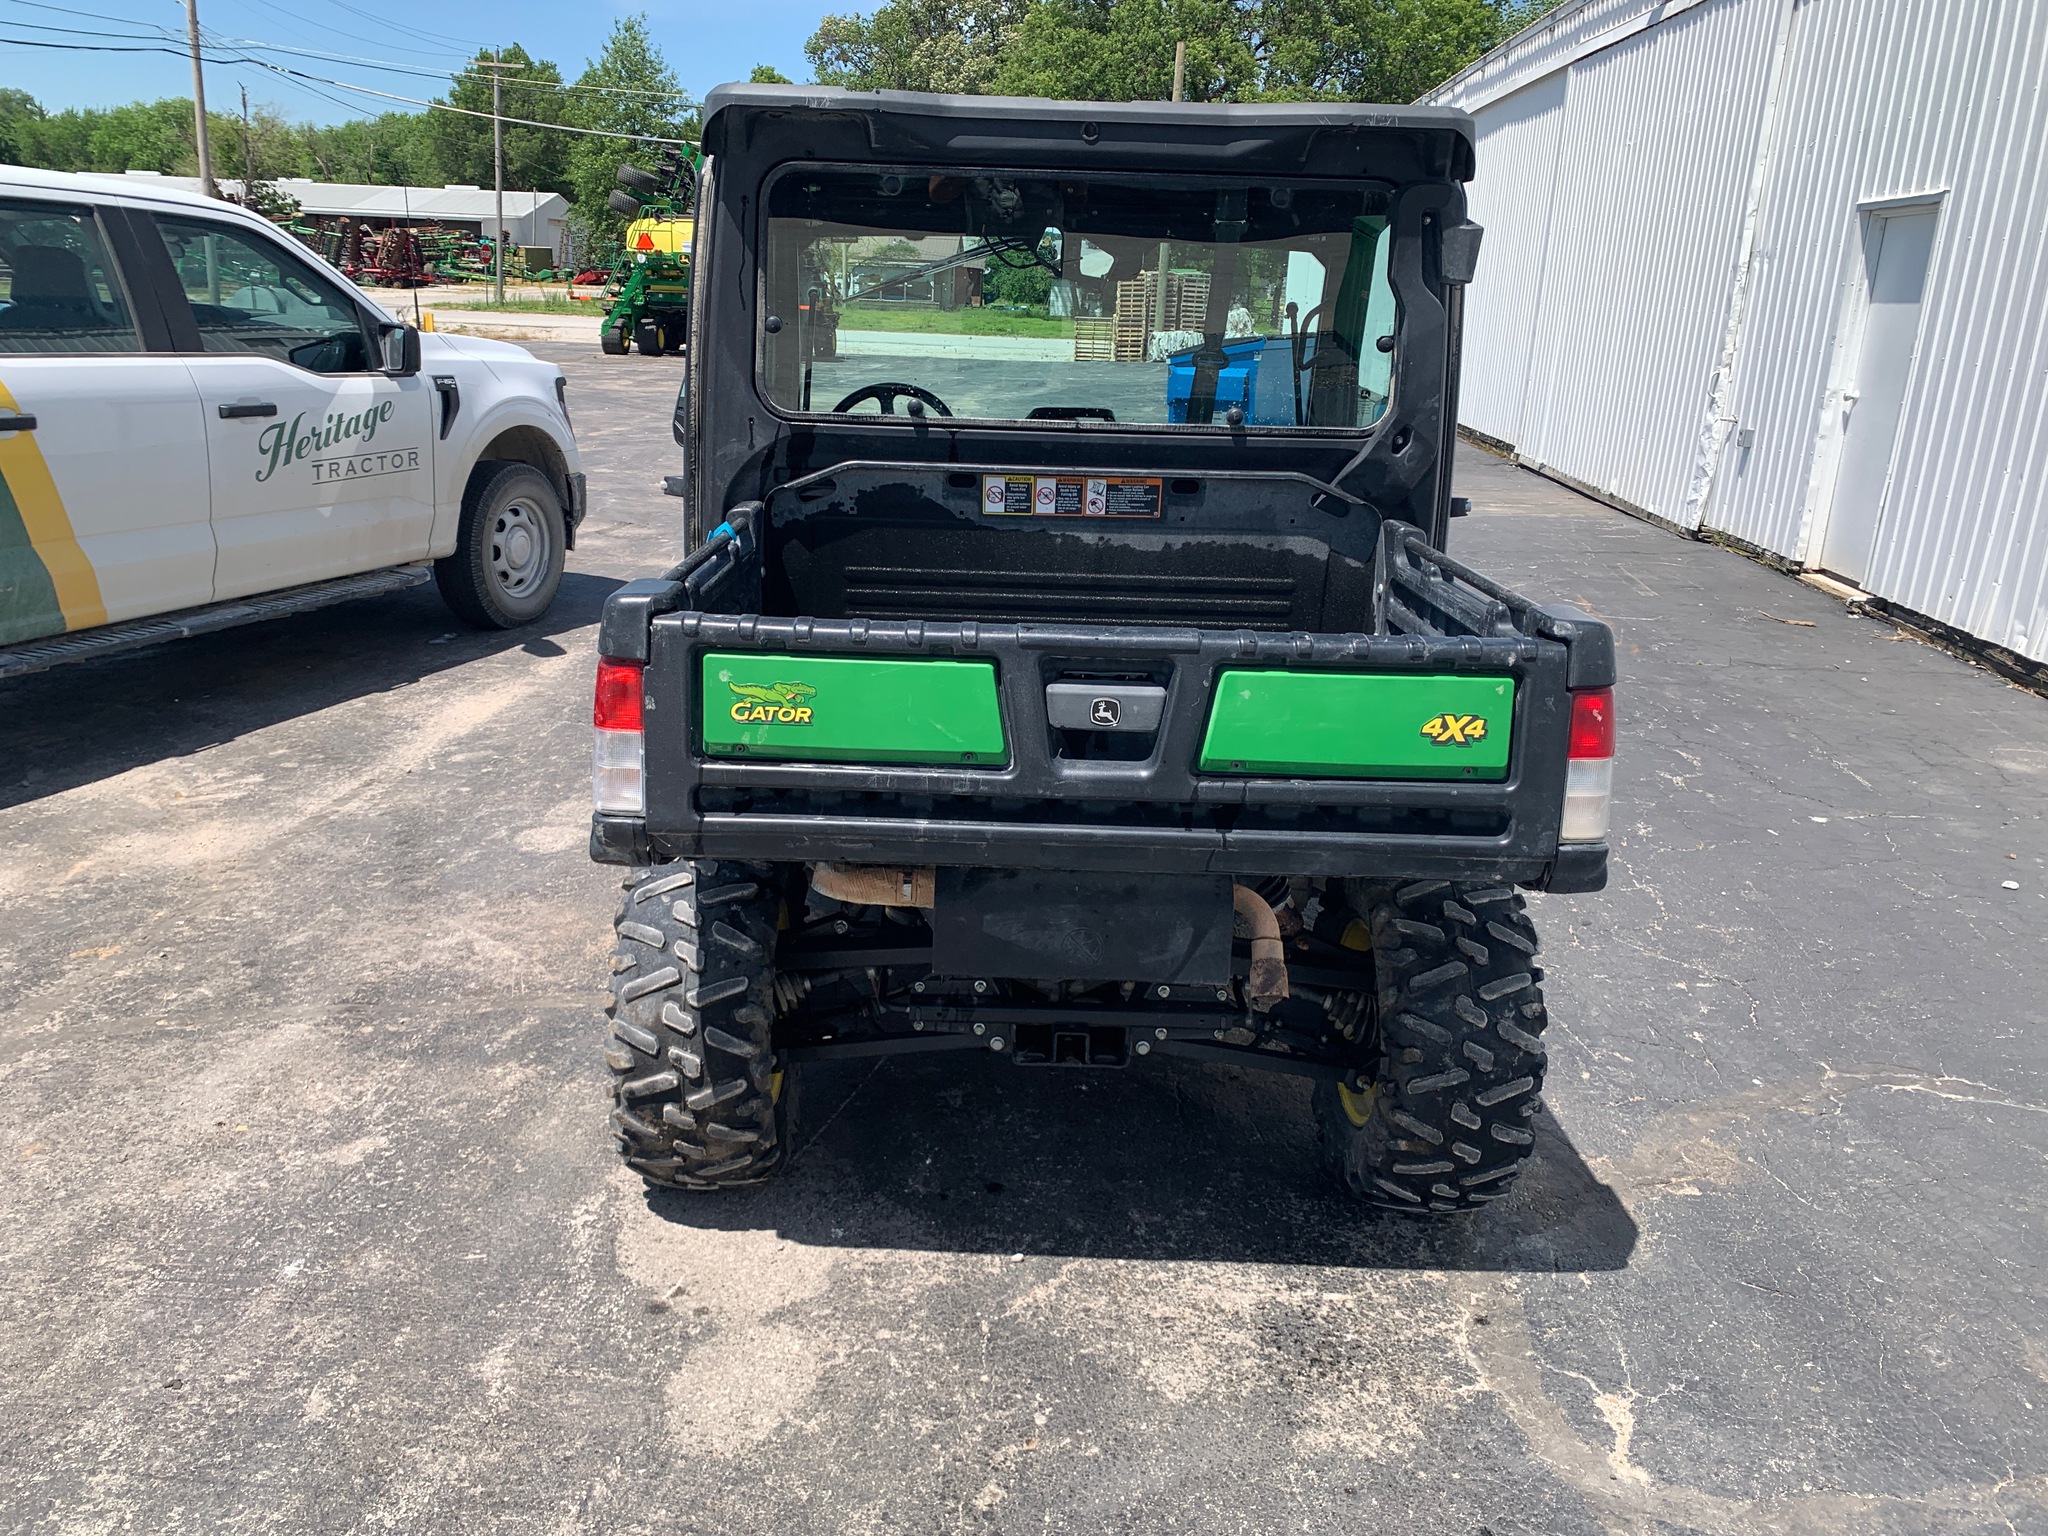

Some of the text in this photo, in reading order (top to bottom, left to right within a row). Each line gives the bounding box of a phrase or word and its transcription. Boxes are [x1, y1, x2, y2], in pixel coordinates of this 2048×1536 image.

[255, 400, 395, 482] Heritage
[312, 451, 419, 480] TRACTOR
[730, 702, 813, 723] GATOR
[1421, 714, 1486, 742] 4X4
